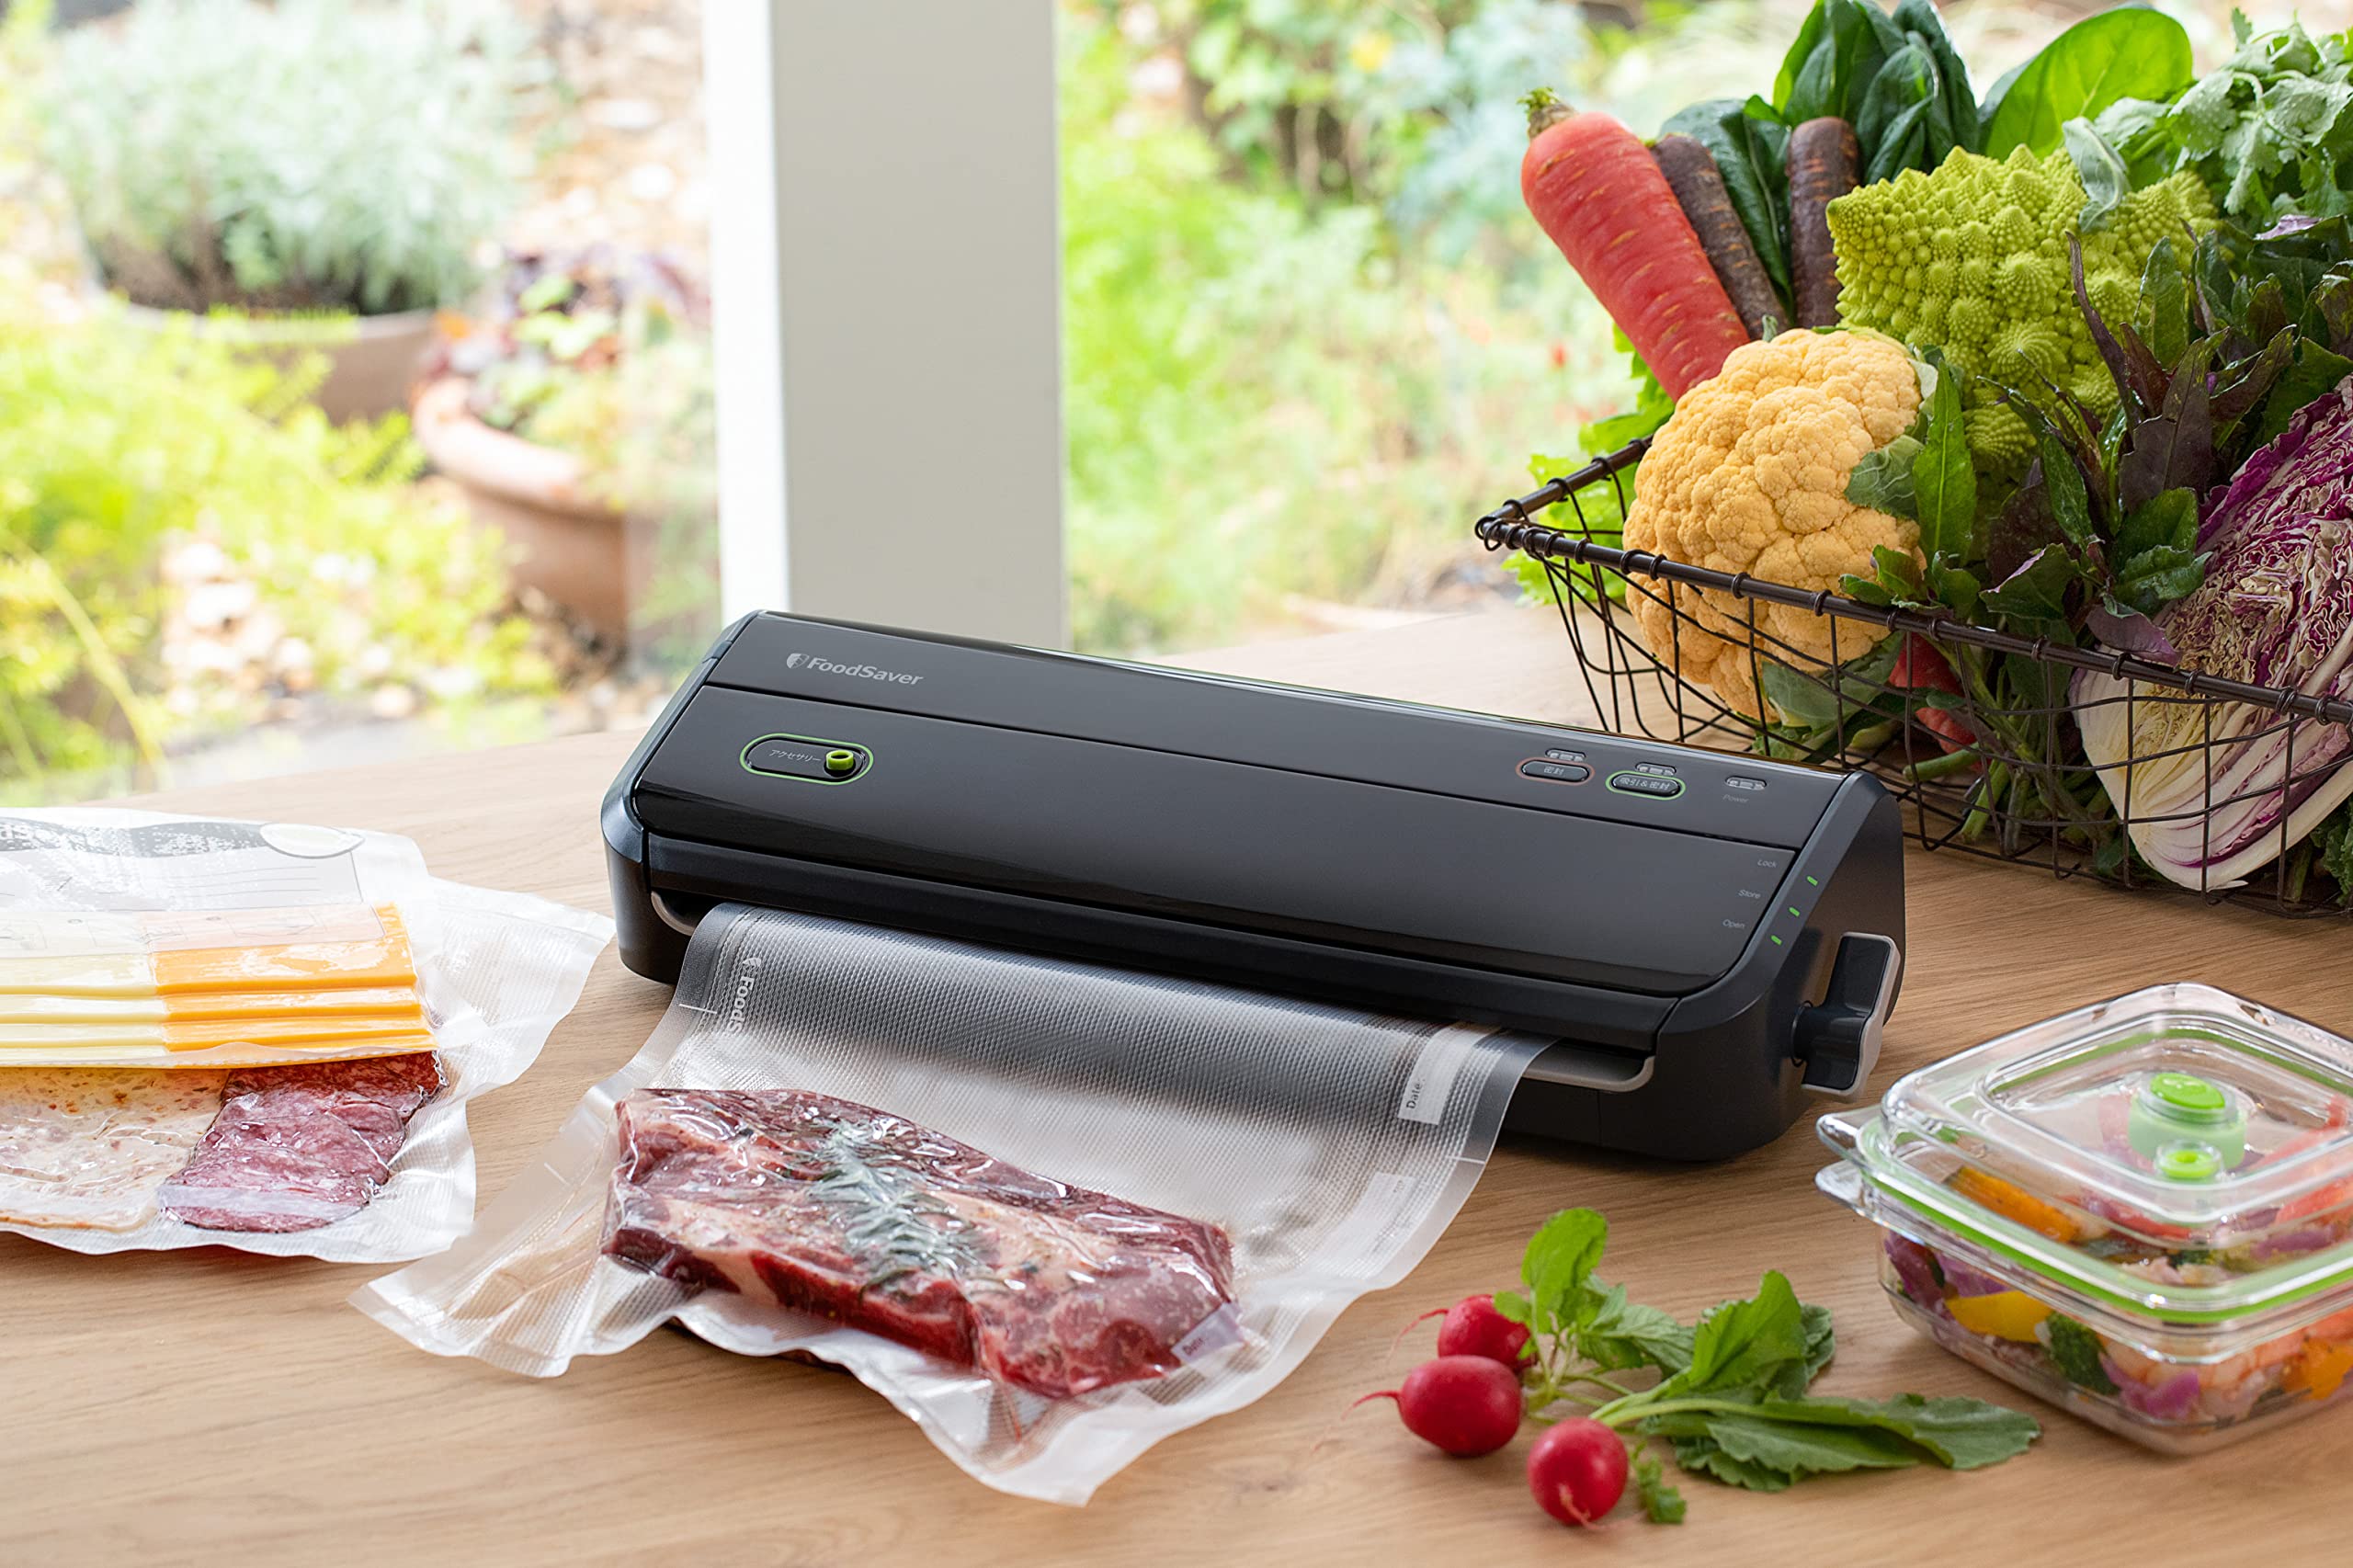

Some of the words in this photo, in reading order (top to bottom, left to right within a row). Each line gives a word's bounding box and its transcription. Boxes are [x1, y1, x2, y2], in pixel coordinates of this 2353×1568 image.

[807, 657, 924, 685] FoodSaver
[768, 749, 822, 762] アクセサリー
[1757, 859, 1777, 868] Lock
[1738, 889, 1761, 899] Store
[1722, 919, 1745, 929] Open
